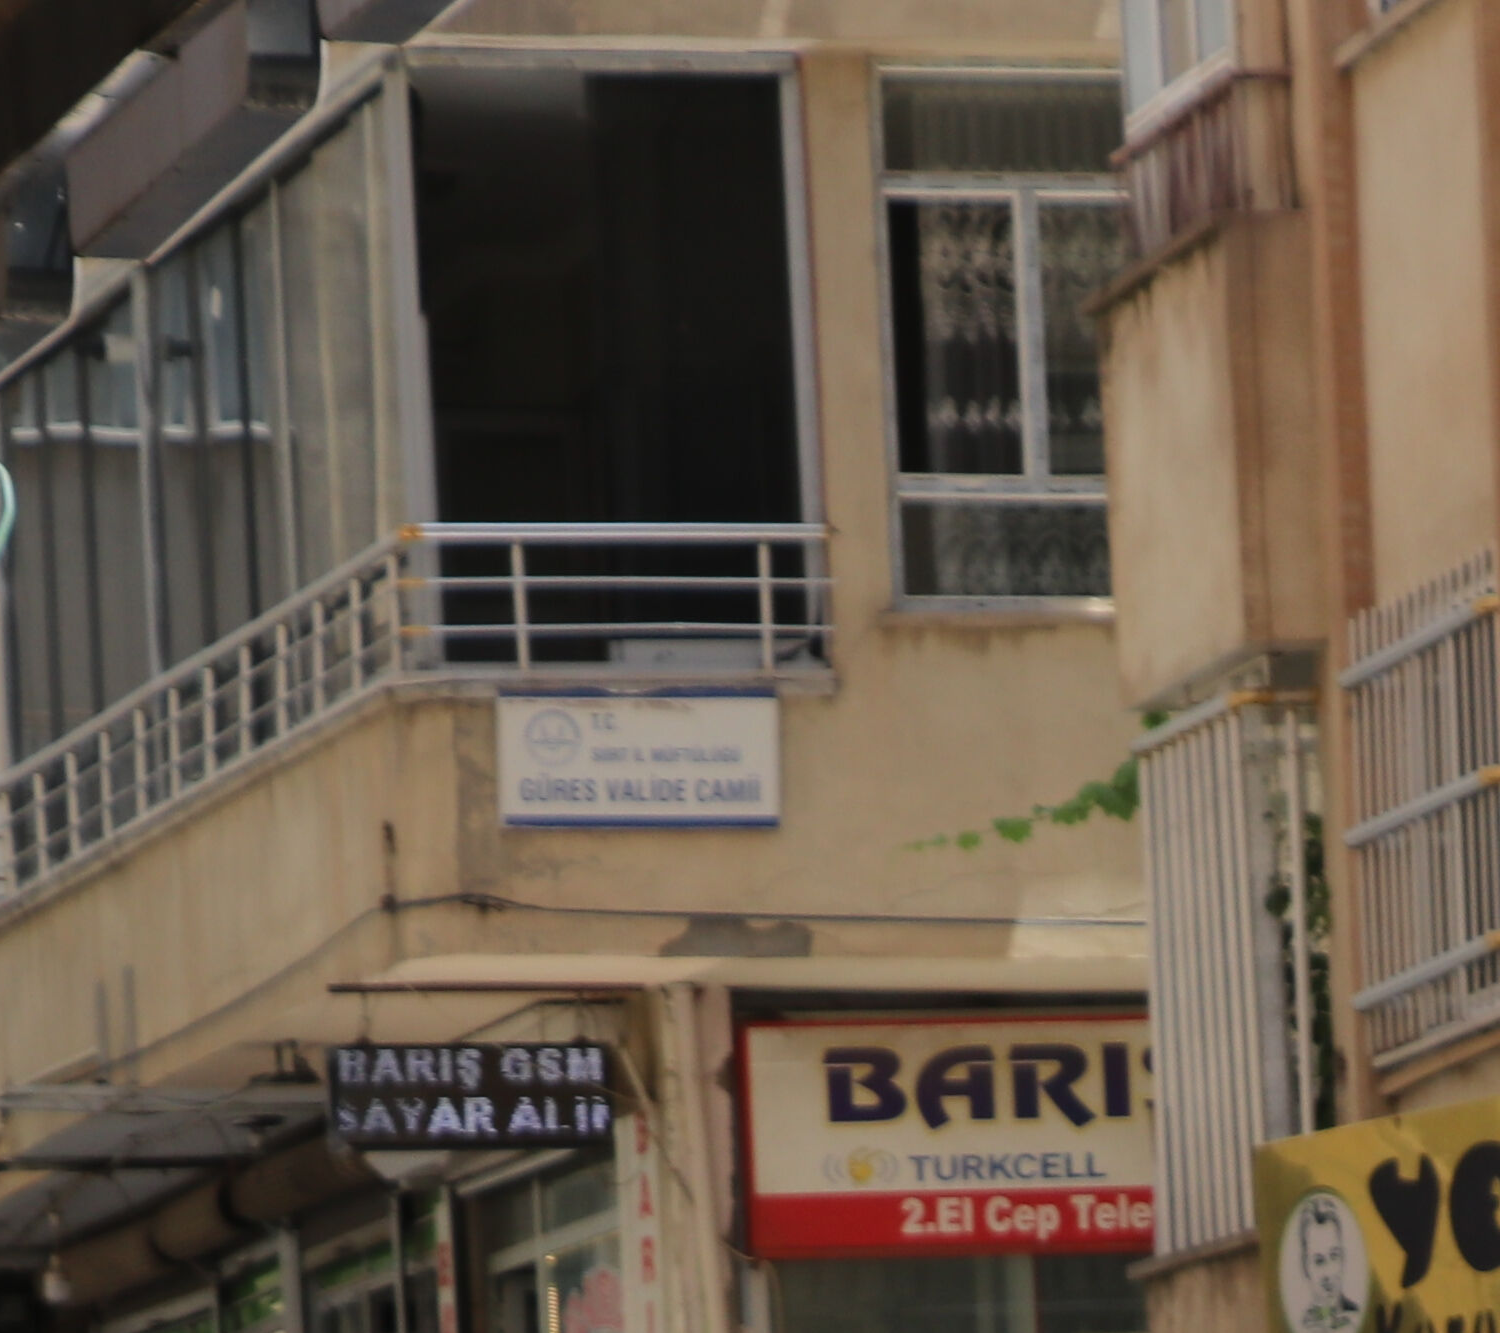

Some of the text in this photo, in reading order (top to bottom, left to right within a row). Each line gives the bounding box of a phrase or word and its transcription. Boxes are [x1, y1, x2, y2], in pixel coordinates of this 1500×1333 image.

[501, 1046, 604, 1082] GSM
[821, 1044, 1155, 1130] BARI
[909, 1153, 1107, 1182] TURKCELL
[986, 1197, 1058, 1241] Cep
